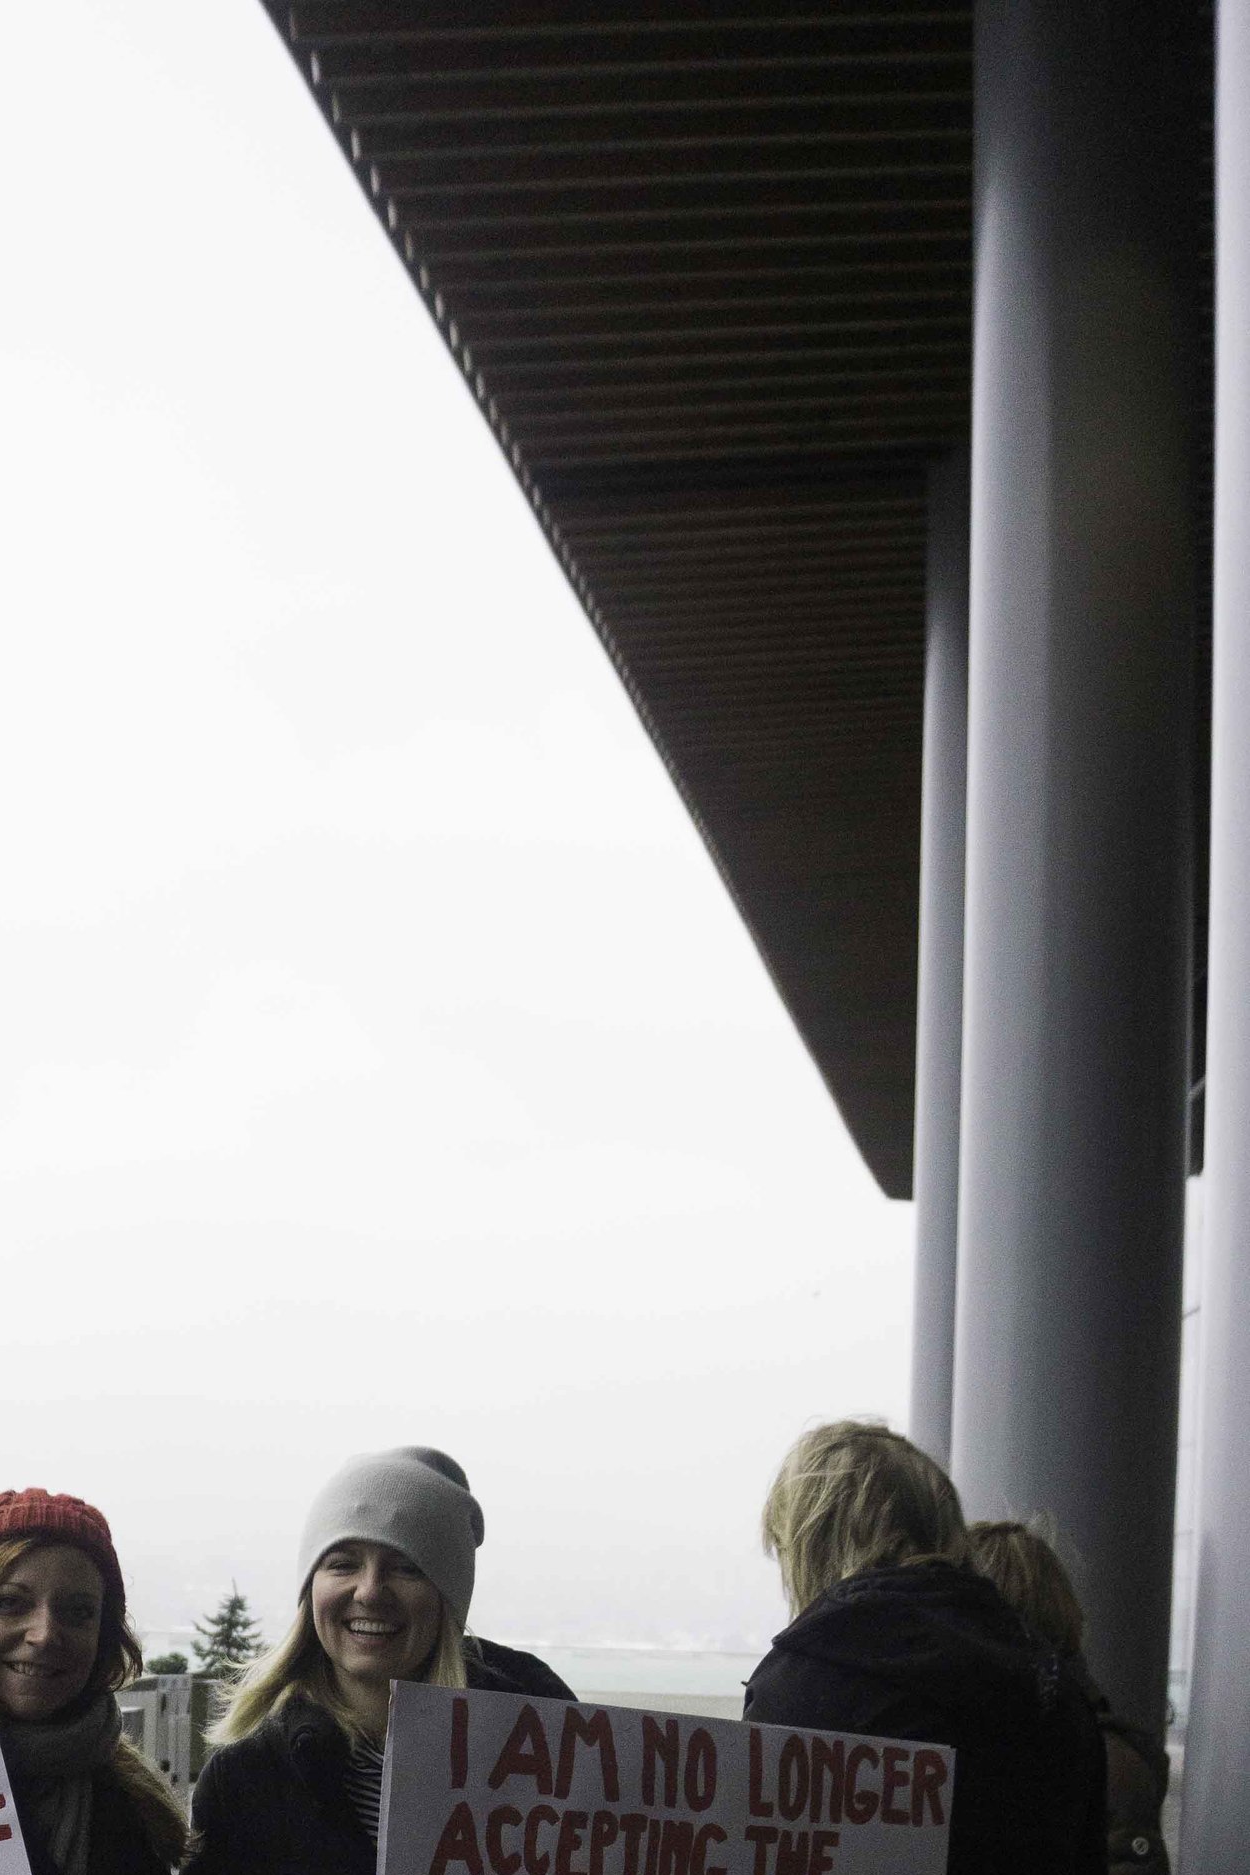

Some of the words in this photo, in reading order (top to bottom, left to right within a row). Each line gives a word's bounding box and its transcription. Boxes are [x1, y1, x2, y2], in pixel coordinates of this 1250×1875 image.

[452, 1698, 469, 1789] I
[488, 1704, 619, 1802] AM
[642, 1716, 717, 1813] NO
[749, 1727, 947, 1827] LONGER
